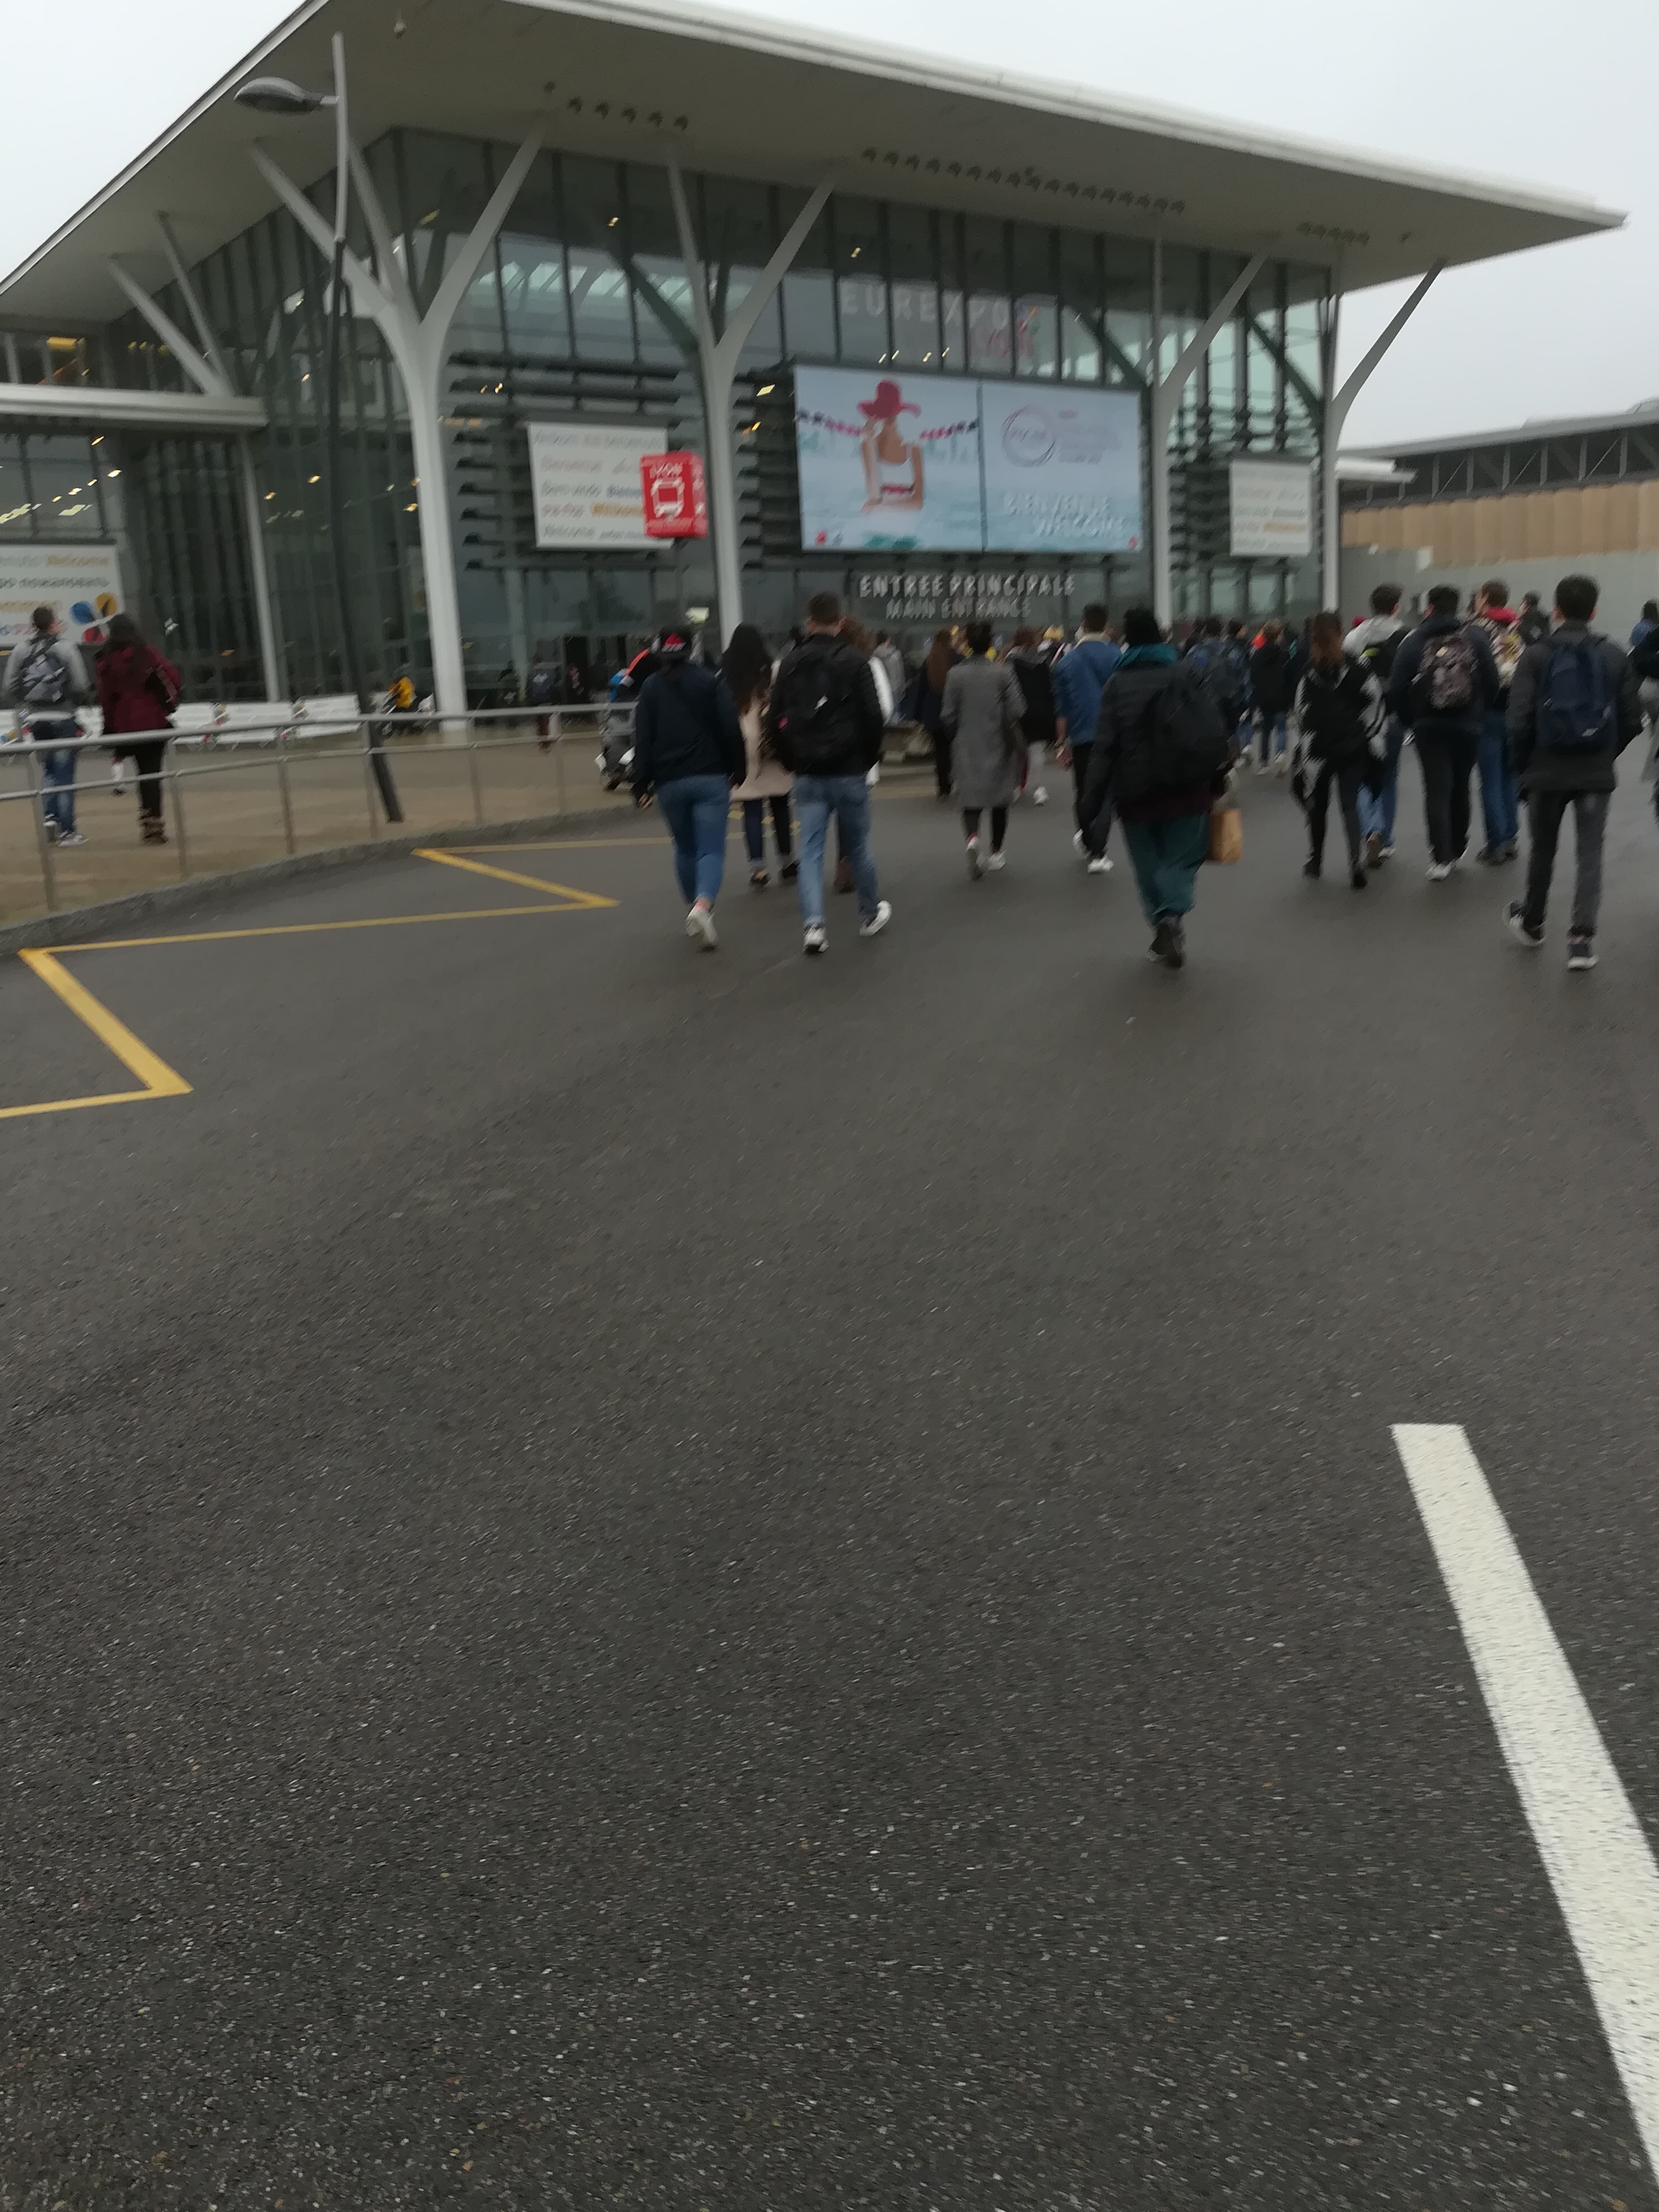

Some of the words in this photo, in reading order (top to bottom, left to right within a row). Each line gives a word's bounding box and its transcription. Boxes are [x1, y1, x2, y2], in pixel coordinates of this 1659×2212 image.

[841, 284, 1010, 328] EUREXPO
[859, 574, 944, 598] ENTREE
[949, 574, 1076, 596] PRINCIPALE
[885, 598, 937, 619] MAIN
[940, 596, 1032, 618] ENTRANCE
